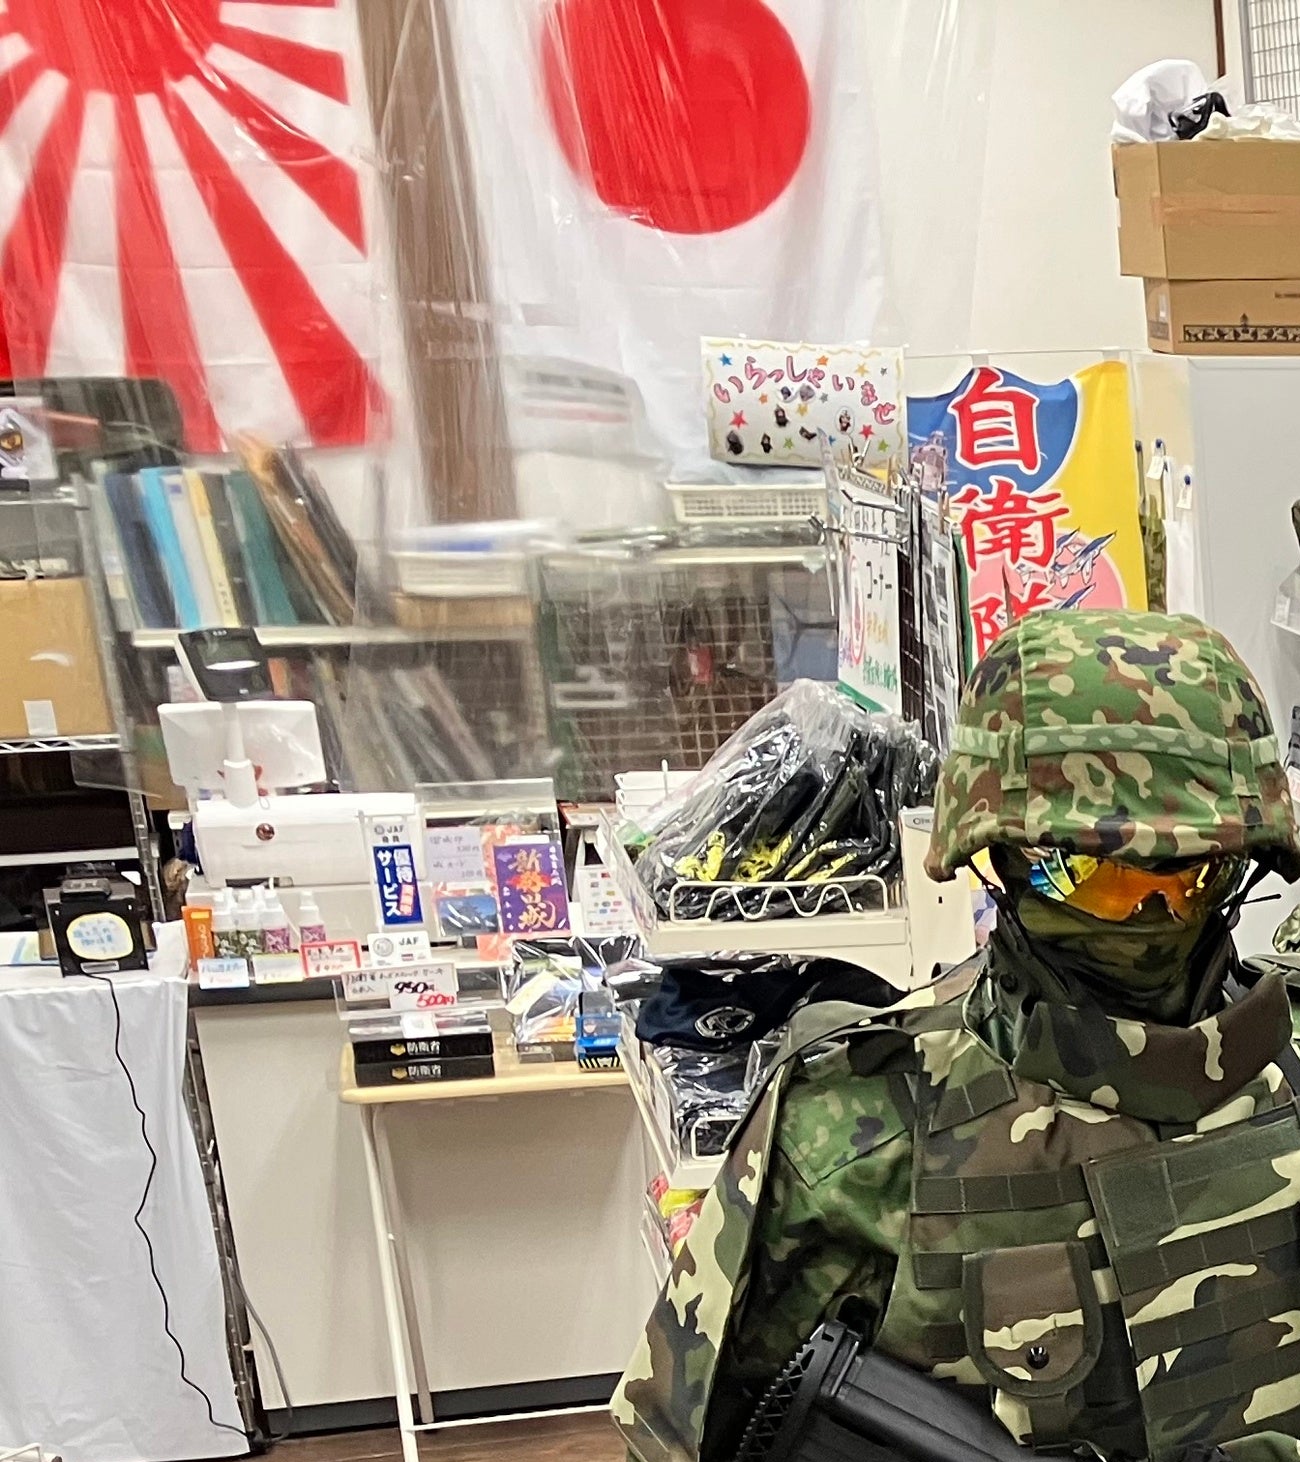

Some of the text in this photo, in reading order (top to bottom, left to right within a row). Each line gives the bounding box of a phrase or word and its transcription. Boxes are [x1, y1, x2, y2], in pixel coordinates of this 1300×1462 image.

[713, 355, 896, 425] いらっしゃいませ
[387, 825, 405, 833] JAF
[377, 850, 401, 917] サービス
[399, 936, 419, 946] JAF
